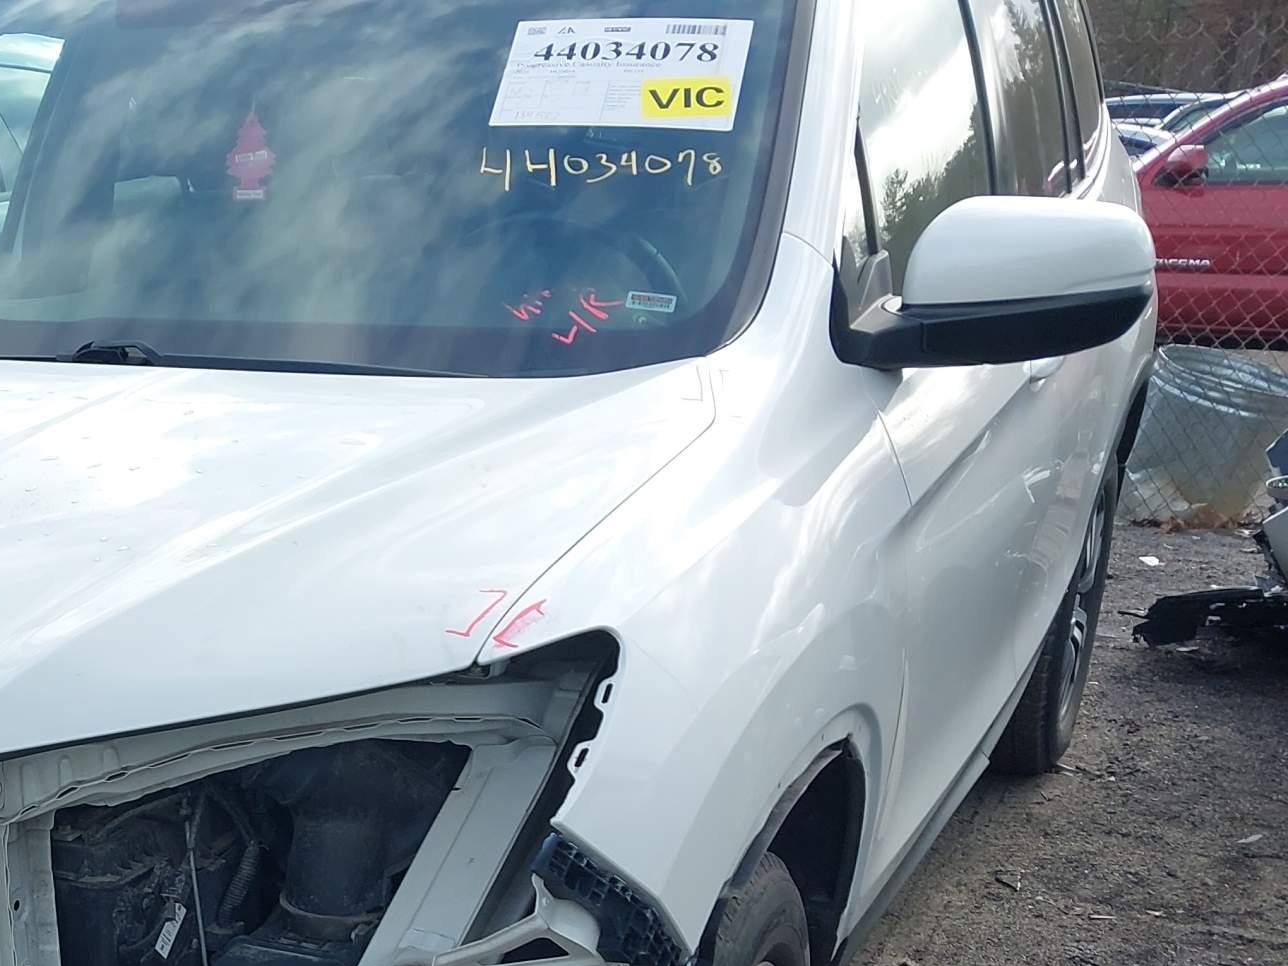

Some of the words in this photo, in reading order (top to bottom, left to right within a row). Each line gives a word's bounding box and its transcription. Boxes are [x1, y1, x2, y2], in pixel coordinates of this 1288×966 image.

[534, 41, 719, 62] 44034078
[648, 86, 725, 109] VIC
[479, 147, 723, 191] 44034078
